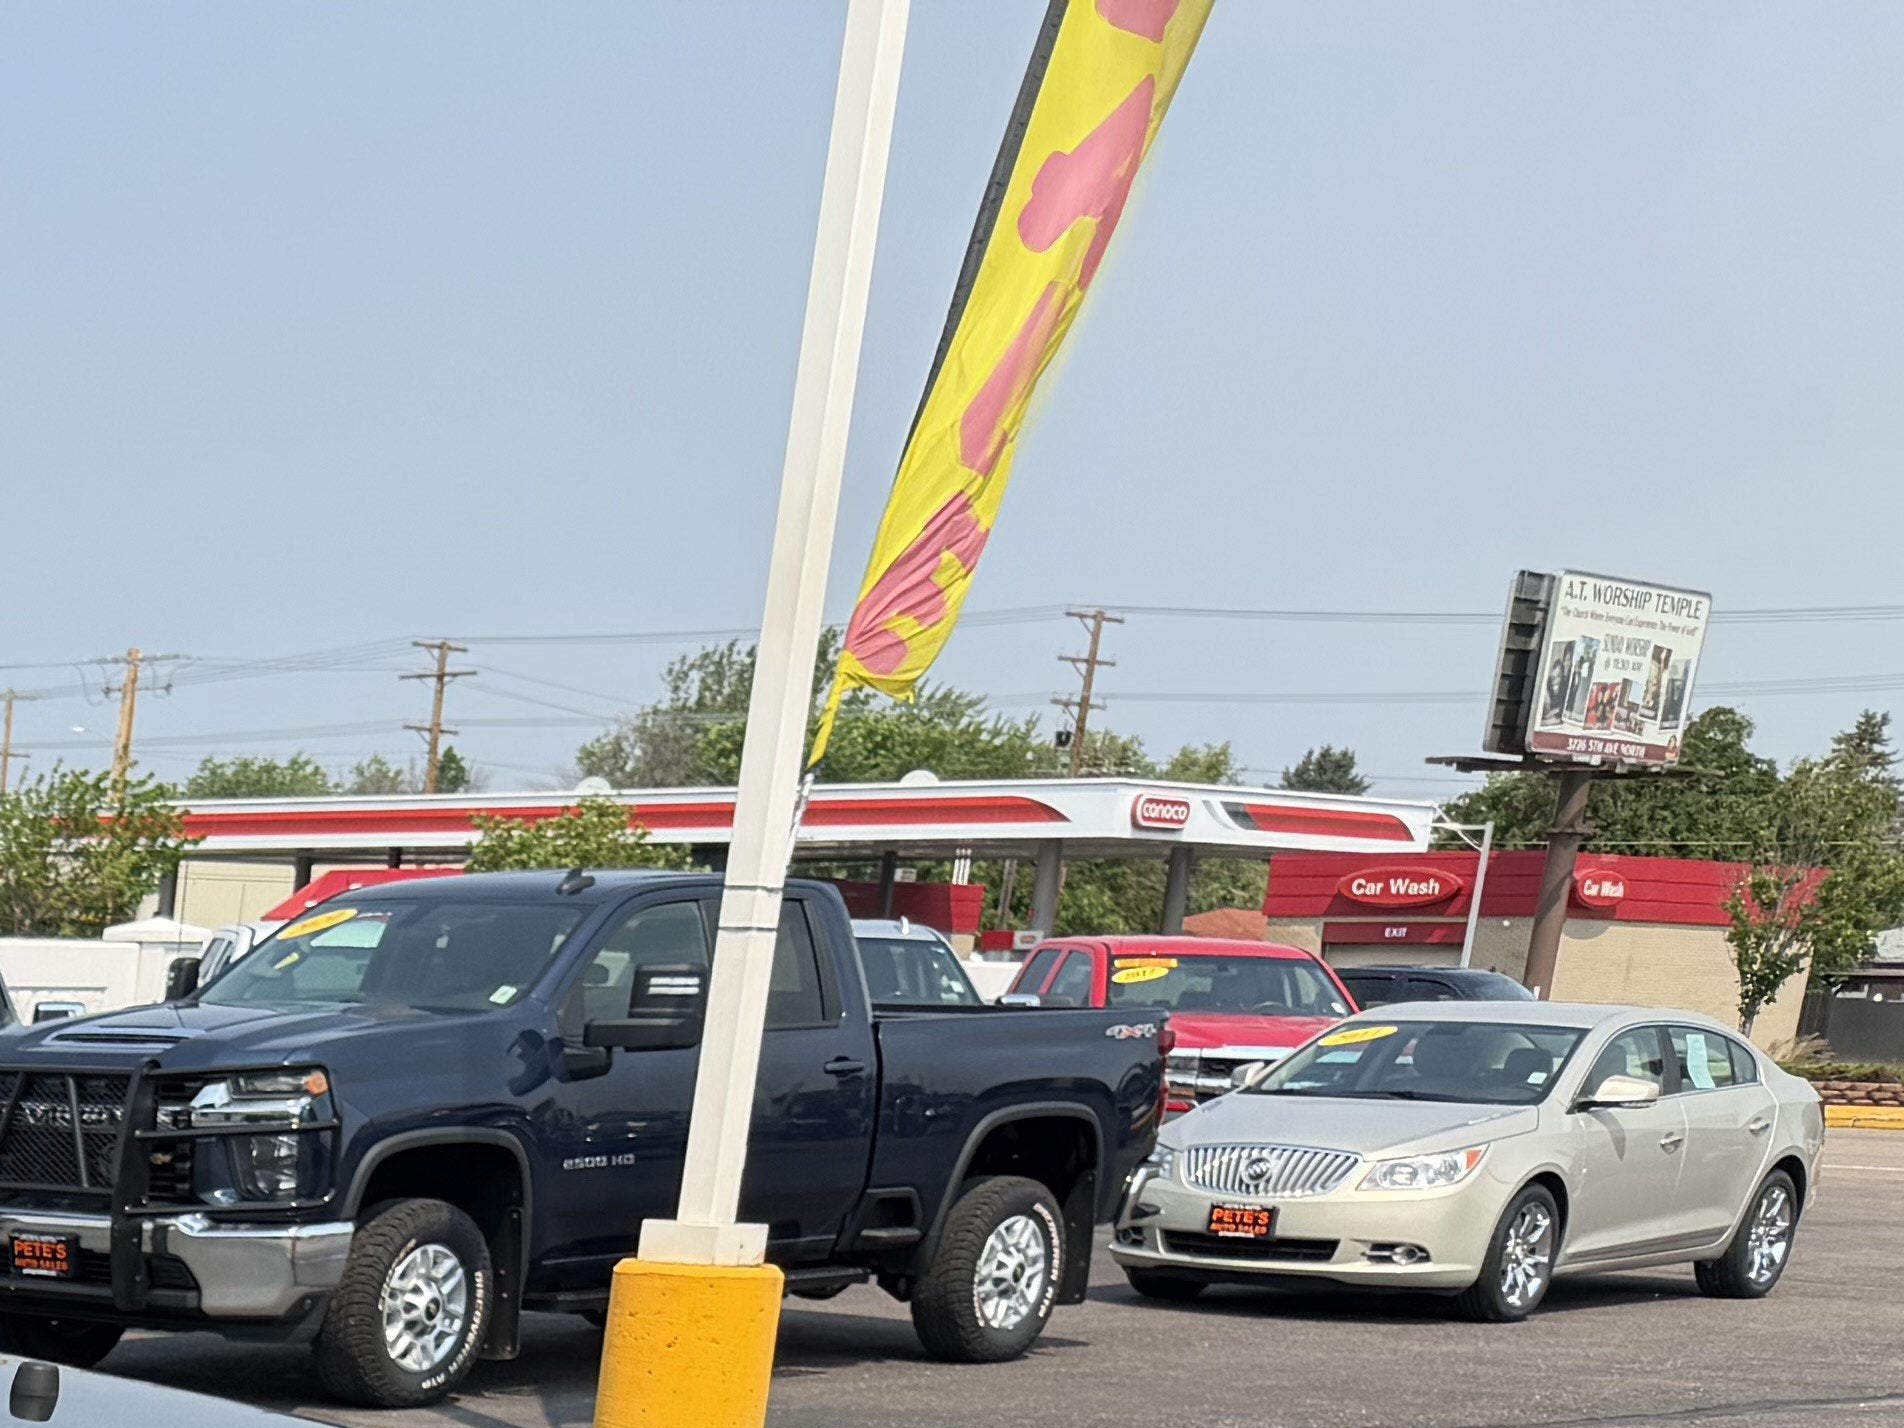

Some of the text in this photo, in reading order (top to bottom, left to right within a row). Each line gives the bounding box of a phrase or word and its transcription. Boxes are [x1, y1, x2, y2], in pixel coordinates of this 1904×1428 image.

[1564, 580, 1703, 620] A.T. WORSHIP TEMPLE
[1351, 877, 1441, 896] Car Wash
[1583, 879, 1624, 898] Car Wash
[1384, 926, 1407, 938] EXIT
[611, 1153, 636, 1167] HD
